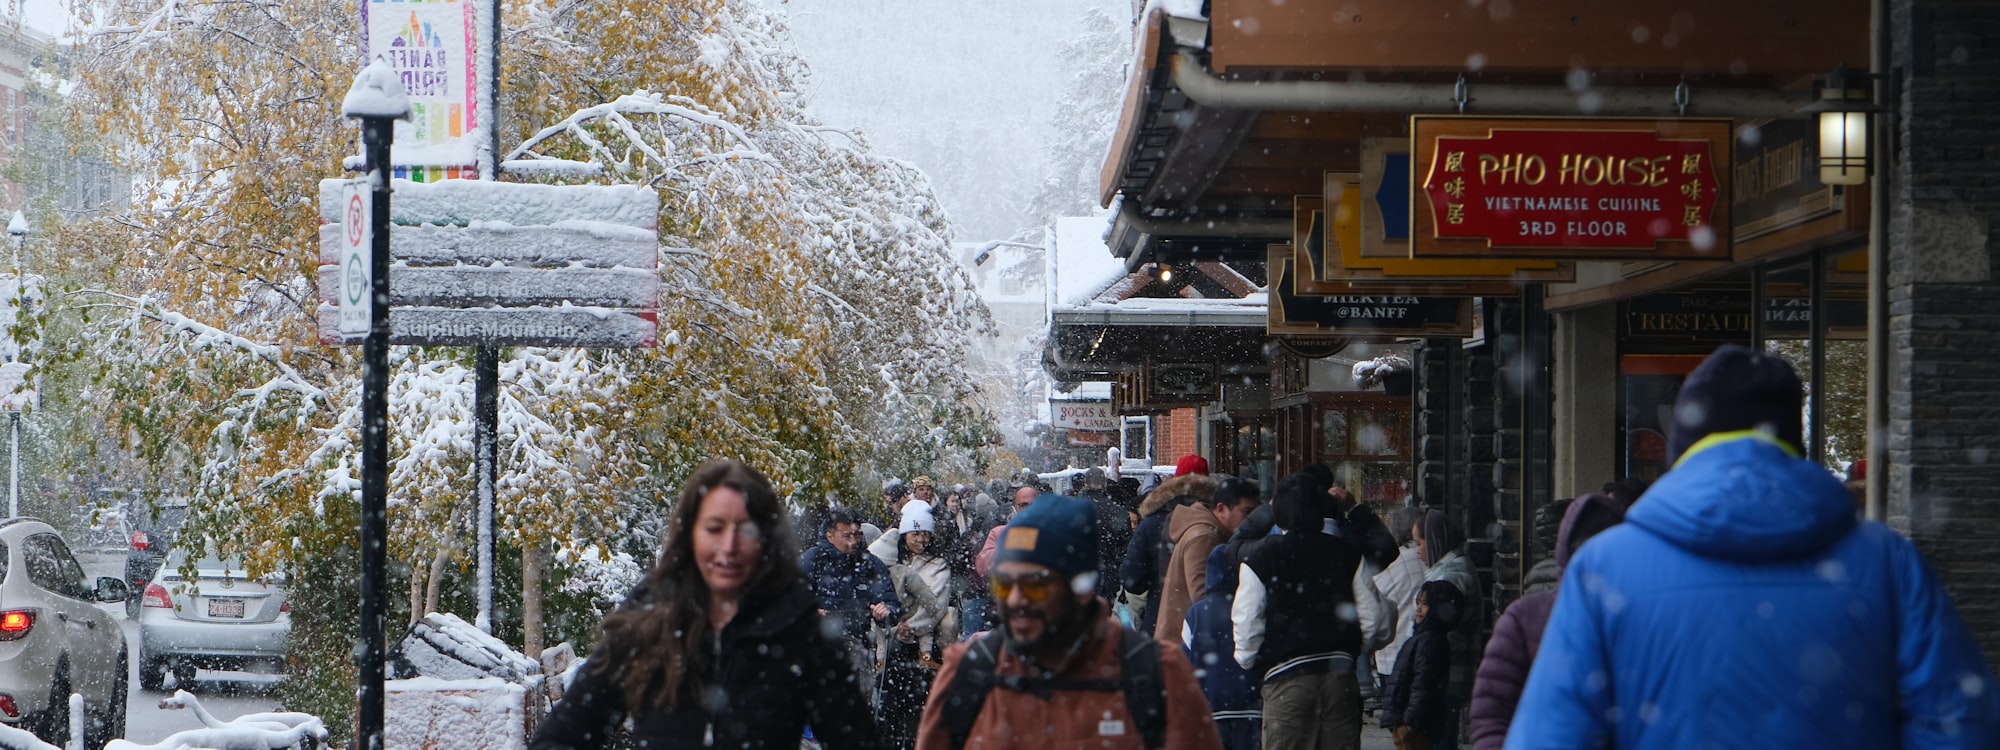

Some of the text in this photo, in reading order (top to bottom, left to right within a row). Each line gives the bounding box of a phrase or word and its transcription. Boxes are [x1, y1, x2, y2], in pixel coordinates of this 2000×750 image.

[1478, 153, 1673, 187] PHO HOUSE
[1443, 151, 1466, 226] 風味居
[1680, 153, 1702, 227] 風味居
[1484, 197, 1663, 212] VIETNAMESE CUISINE
[1519, 220, 1628, 236] 3RD FLOOR
[1336, 307, 1408, 319] @BANFF
[396, 320, 574, 340] Sulphur Mountain
[1084, 418, 1114, 428] CANADA
[912, 519, 921, 530] LA
